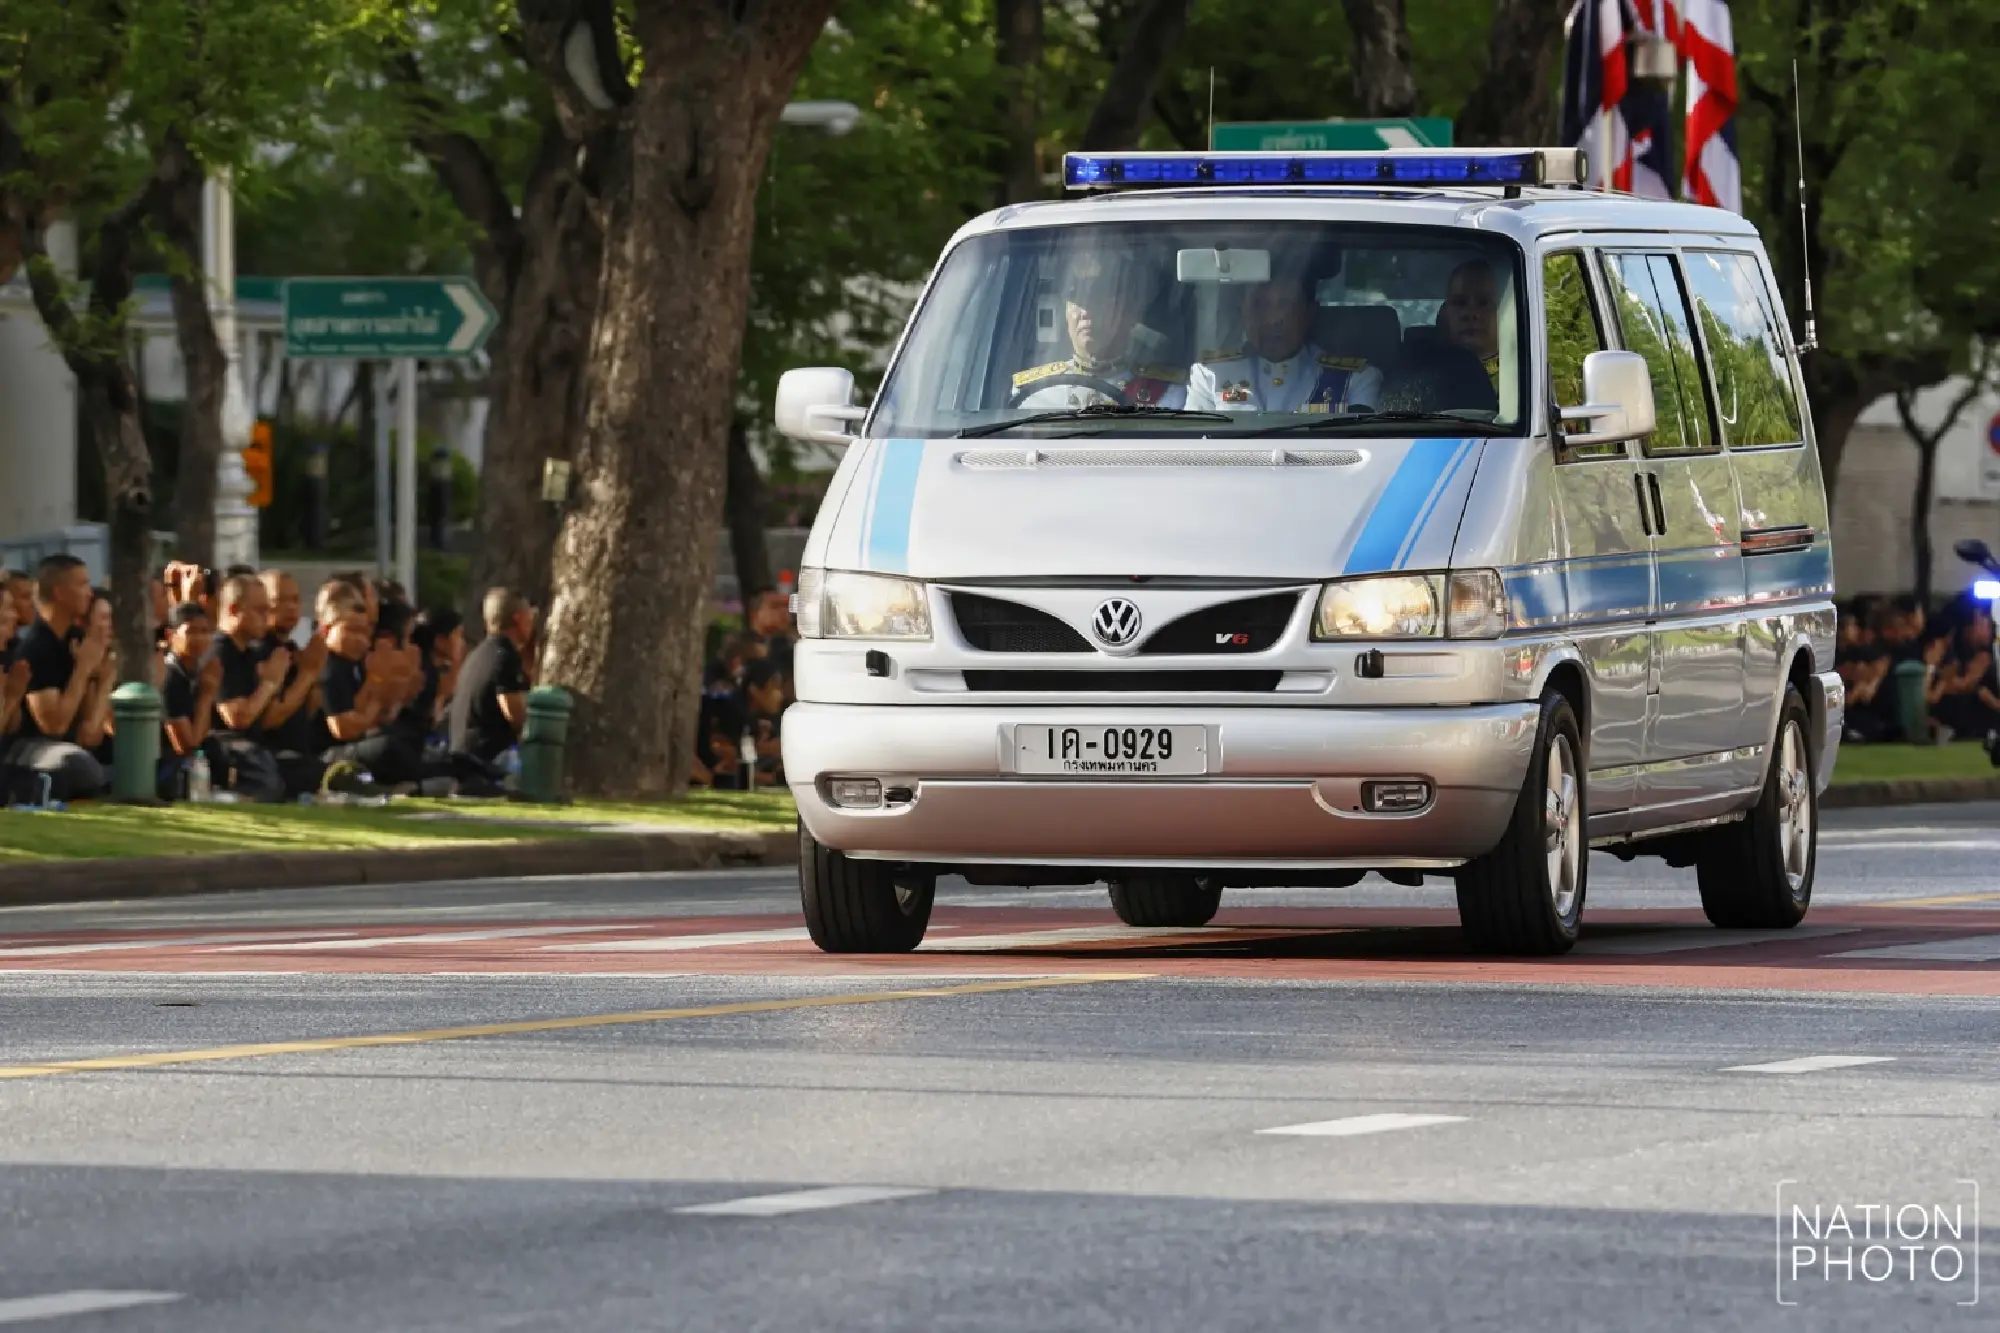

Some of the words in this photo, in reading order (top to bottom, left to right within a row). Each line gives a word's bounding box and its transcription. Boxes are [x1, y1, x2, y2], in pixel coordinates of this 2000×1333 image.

[1216, 633, 1248, 645] V6
[1063, 760, 1158, 773] กรุงเทพมหานคร
